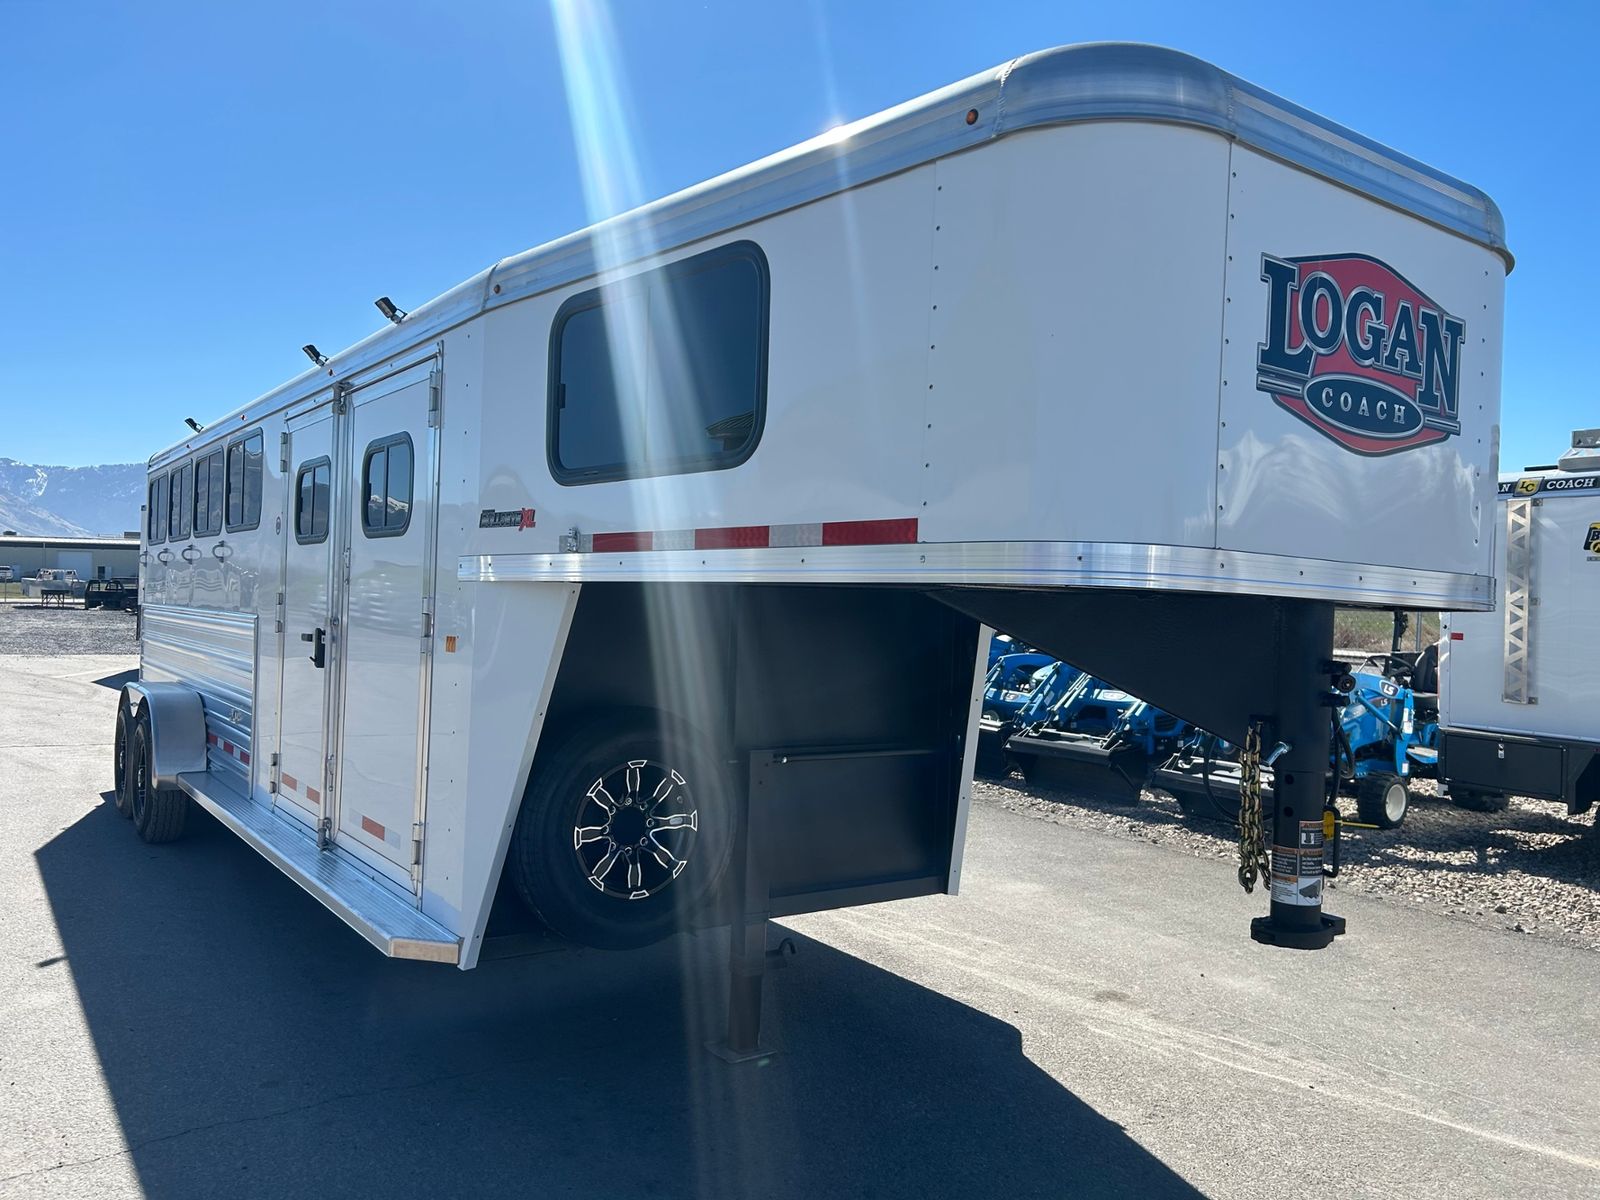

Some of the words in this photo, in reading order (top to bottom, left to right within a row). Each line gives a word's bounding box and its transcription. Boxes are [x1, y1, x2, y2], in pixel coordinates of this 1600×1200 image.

[1257, 252, 1466, 419] LOGAN
[1321, 387, 1406, 425] COACH
[1546, 478, 1595, 490] COACH
[1384, 684, 1395, 695] LS
